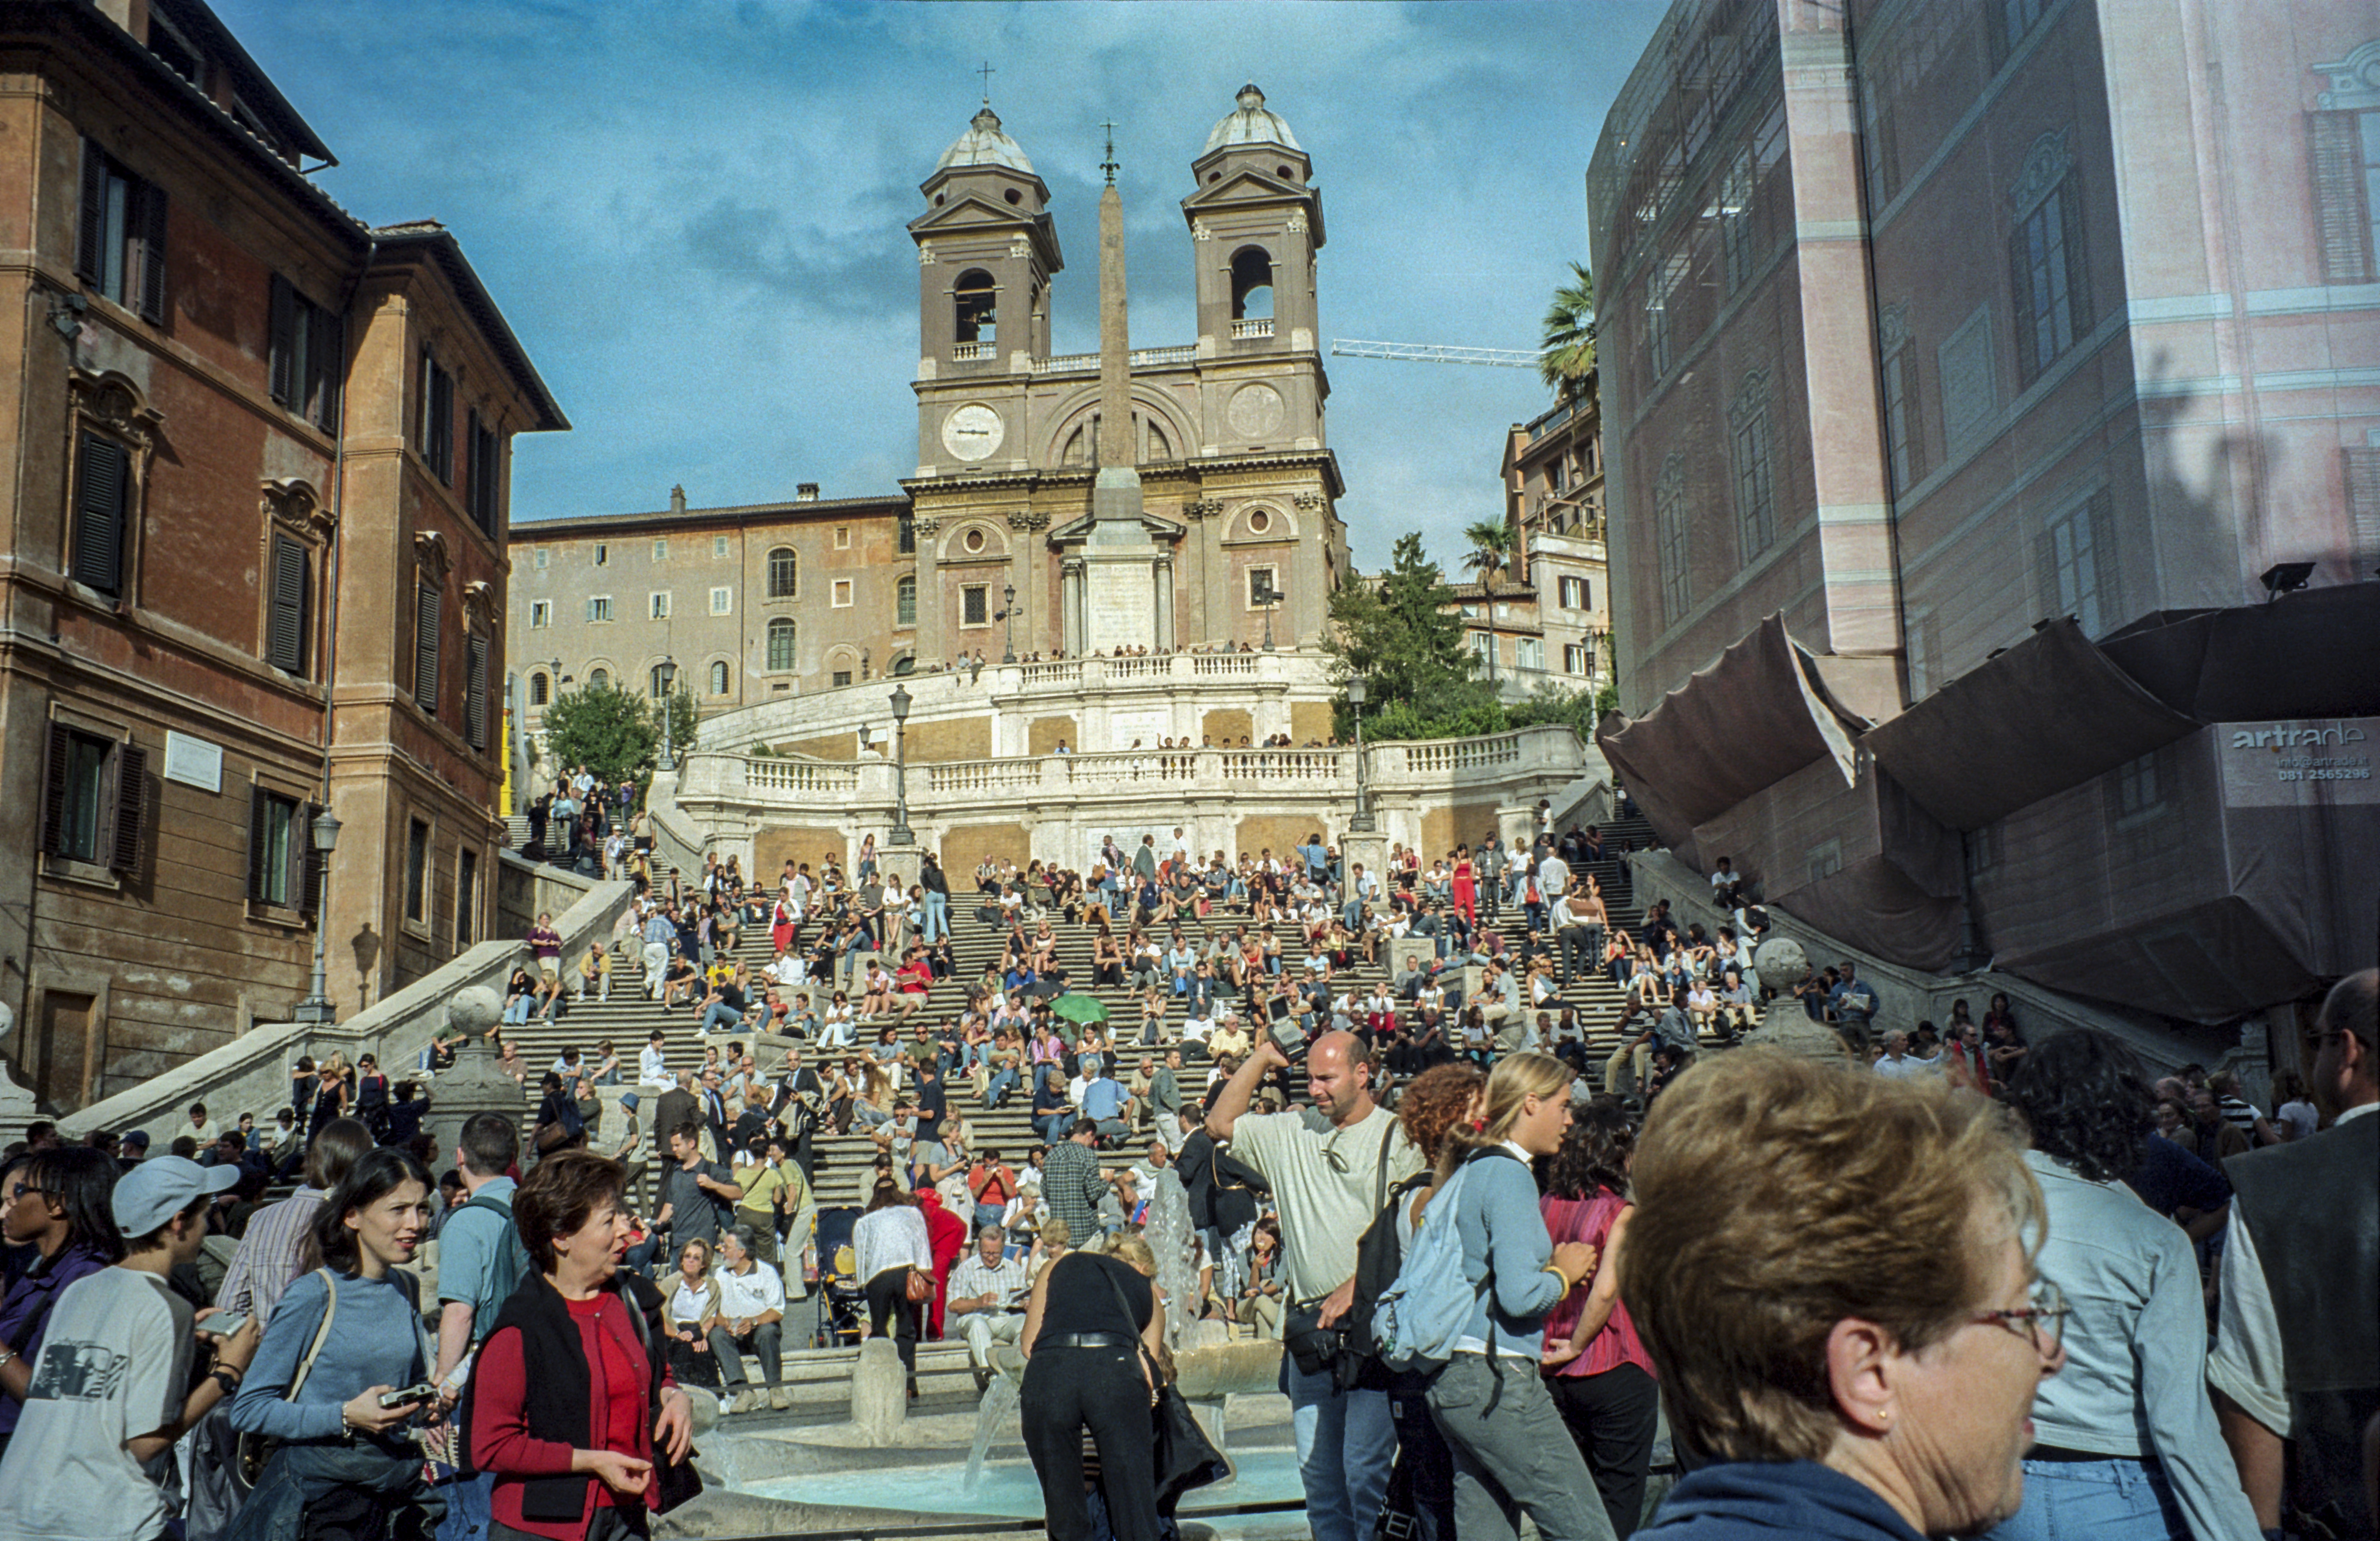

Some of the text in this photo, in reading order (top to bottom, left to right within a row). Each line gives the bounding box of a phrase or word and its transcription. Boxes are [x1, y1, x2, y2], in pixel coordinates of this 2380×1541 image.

[2234, 721, 2365, 748] artrade
[2278, 756, 2368, 768] info@artrade.it
[2279, 770, 2303, 780] 081
